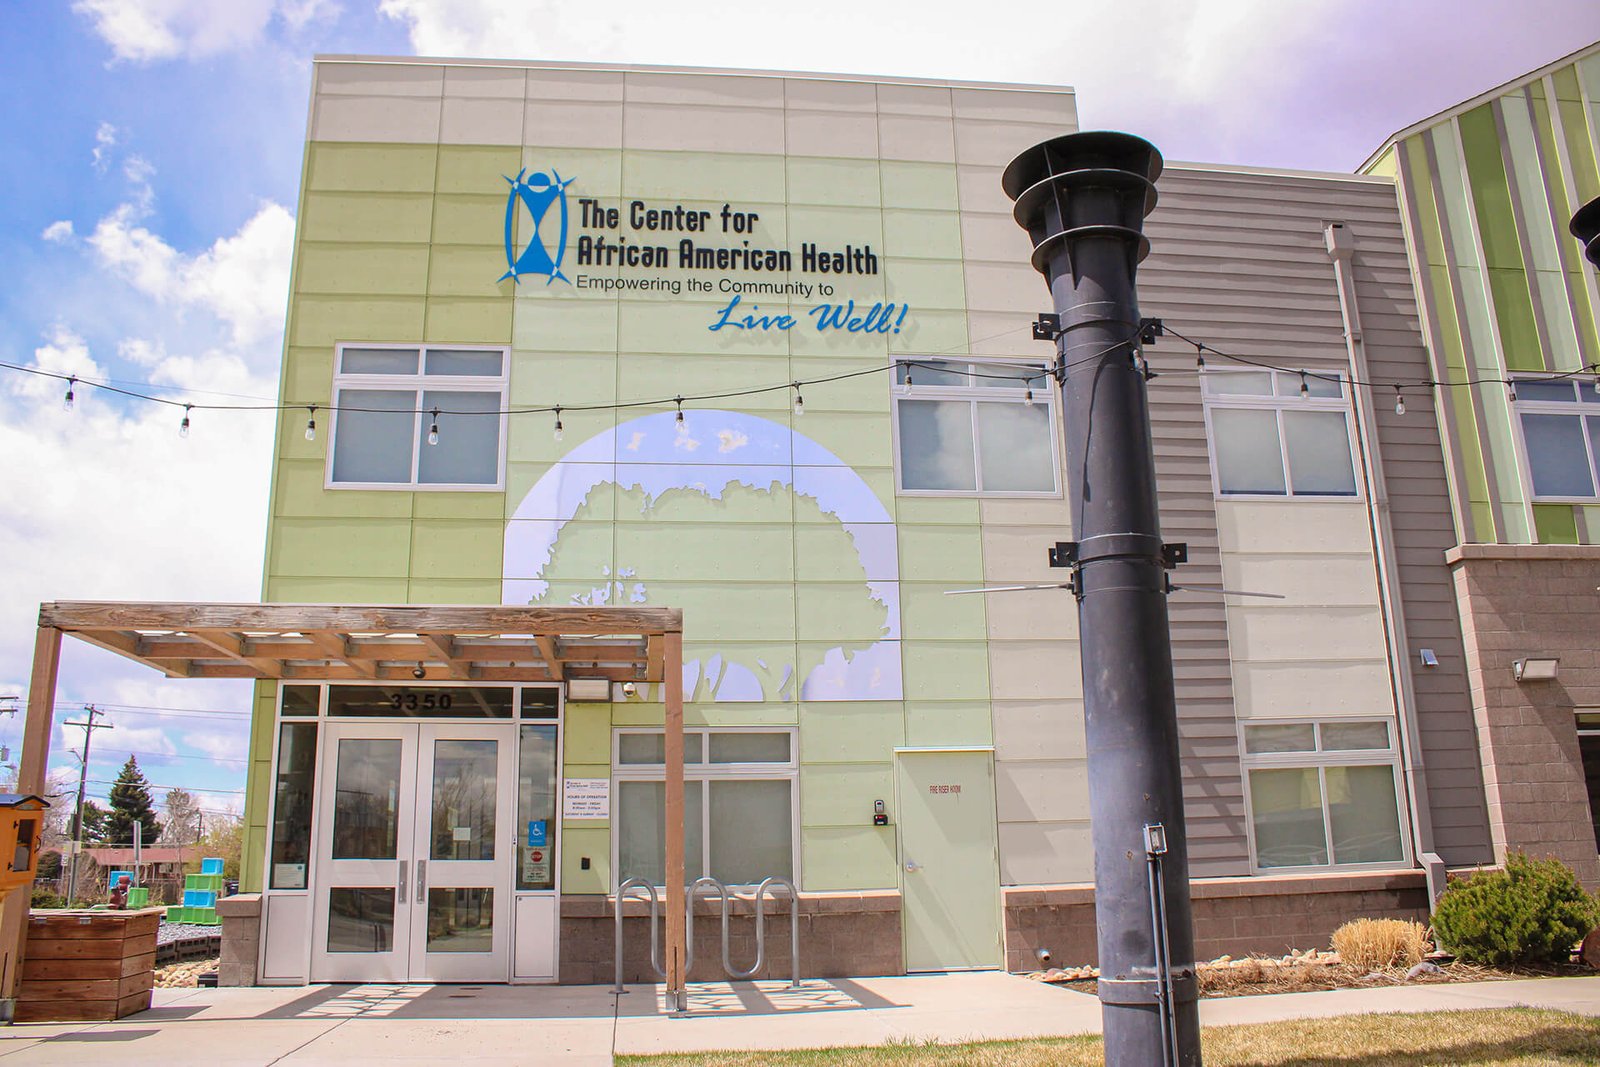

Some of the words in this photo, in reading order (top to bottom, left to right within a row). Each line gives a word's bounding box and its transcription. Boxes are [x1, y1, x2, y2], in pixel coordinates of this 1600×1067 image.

[578, 198, 619, 230] The
[630, 200, 711, 232] Center
[720, 203, 759, 234] for
[577, 235, 668, 269] African
[679, 239, 792, 272] American
[802, 243, 878, 276] Health
[576, 275, 681, 295] Empowering
[687, 278, 713, 293] the
[719, 279, 813, 299] Community
[817, 282, 834, 297] to
[708, 295, 797, 332] Live
[809, 300, 909, 335] Well!
[391, 693, 452, 710] 3350
